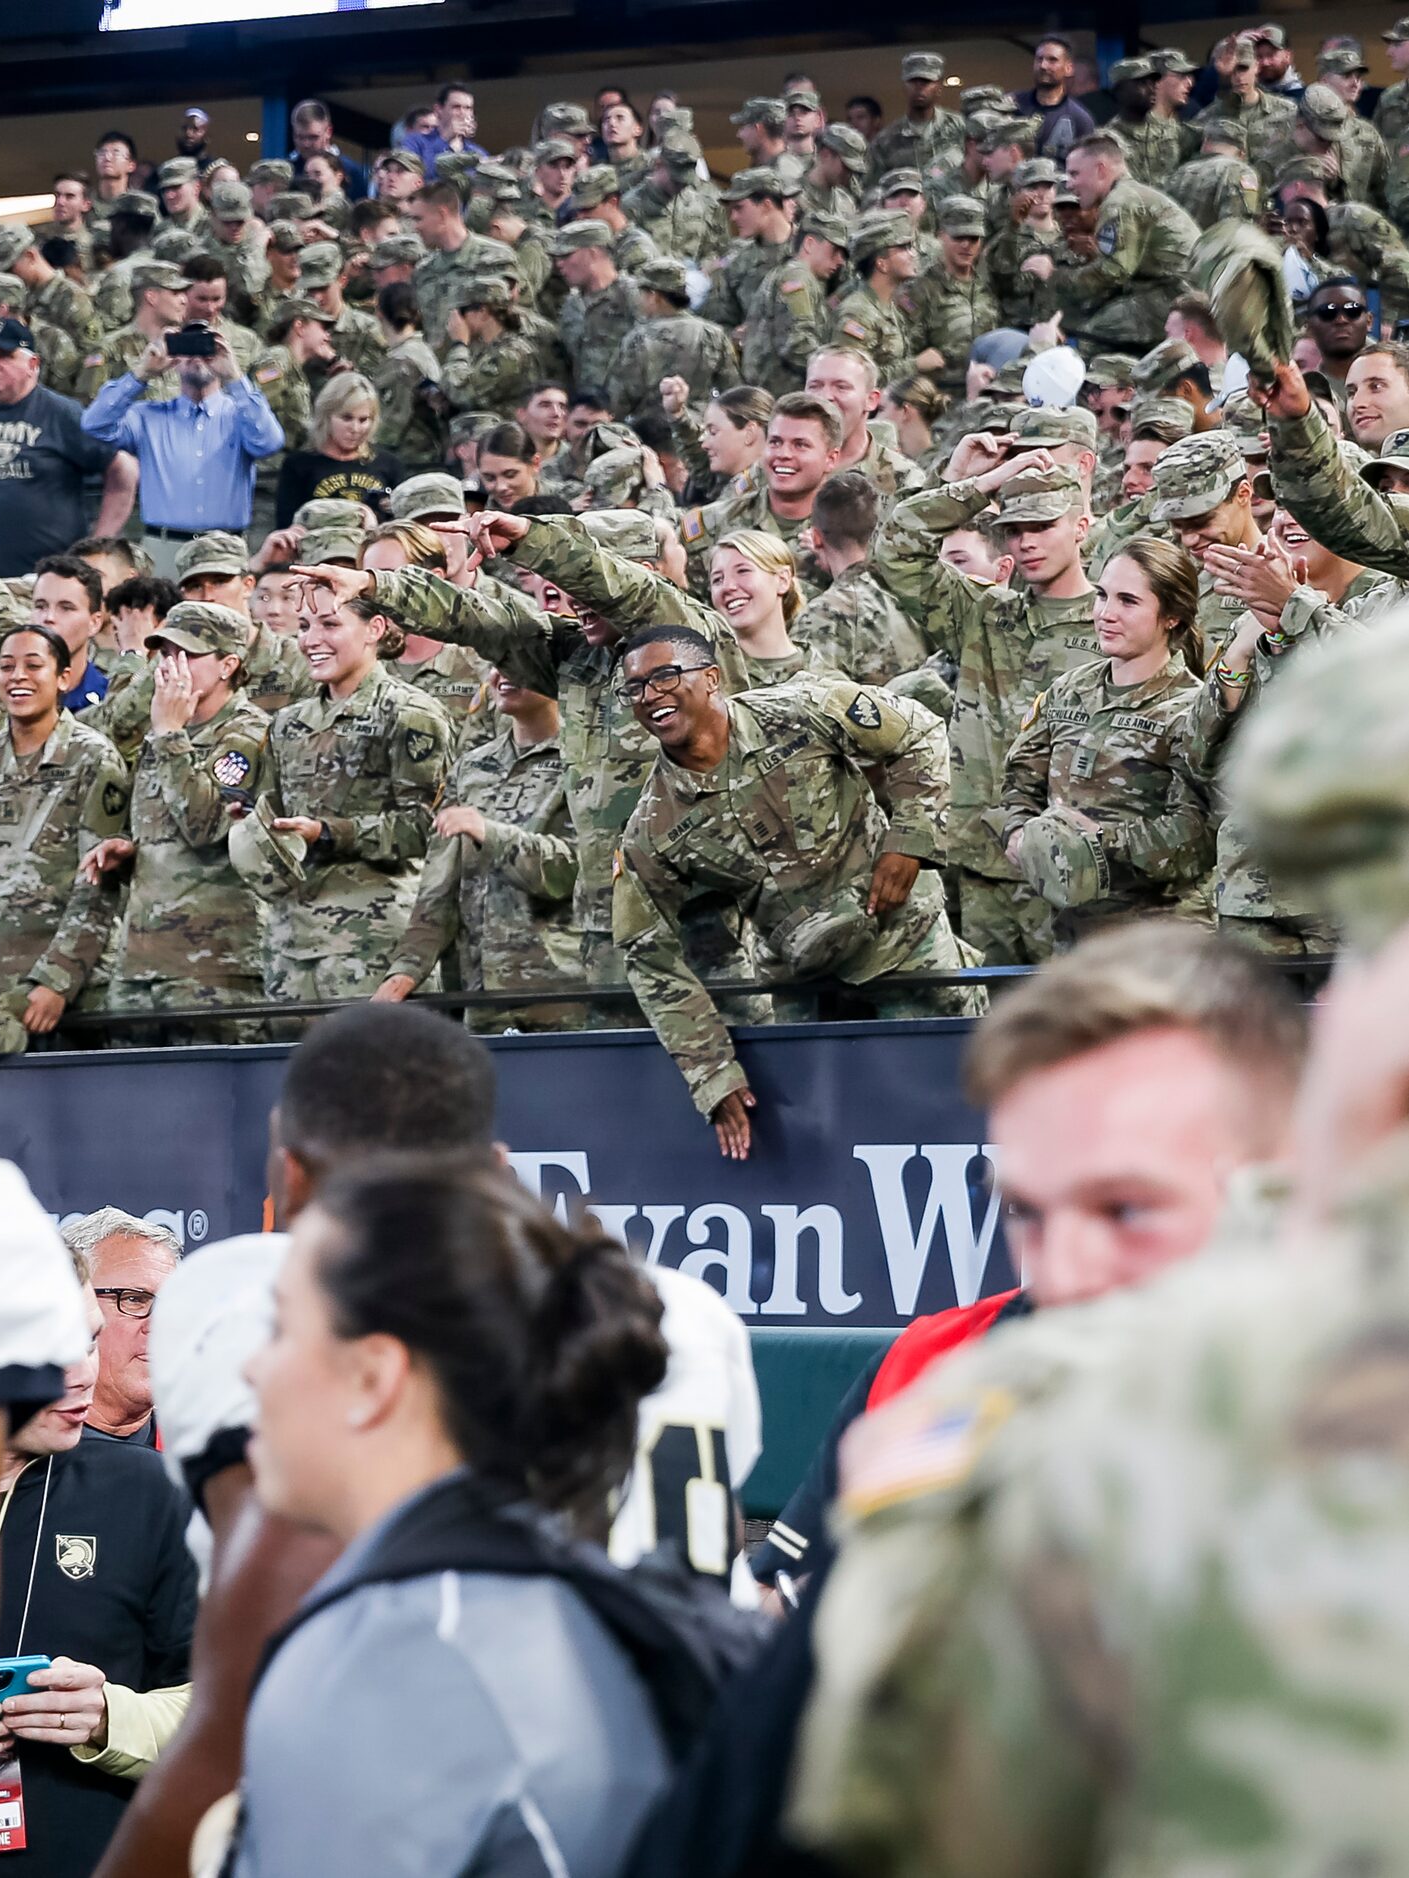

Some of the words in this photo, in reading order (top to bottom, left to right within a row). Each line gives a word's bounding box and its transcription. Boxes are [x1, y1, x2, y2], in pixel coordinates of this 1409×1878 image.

[1118, 717, 1131, 727] U.S.
[1132, 718, 1158, 733] ARMY
[763, 753, 782, 770] U.S.
[667, 816, 694, 842] GRANT
